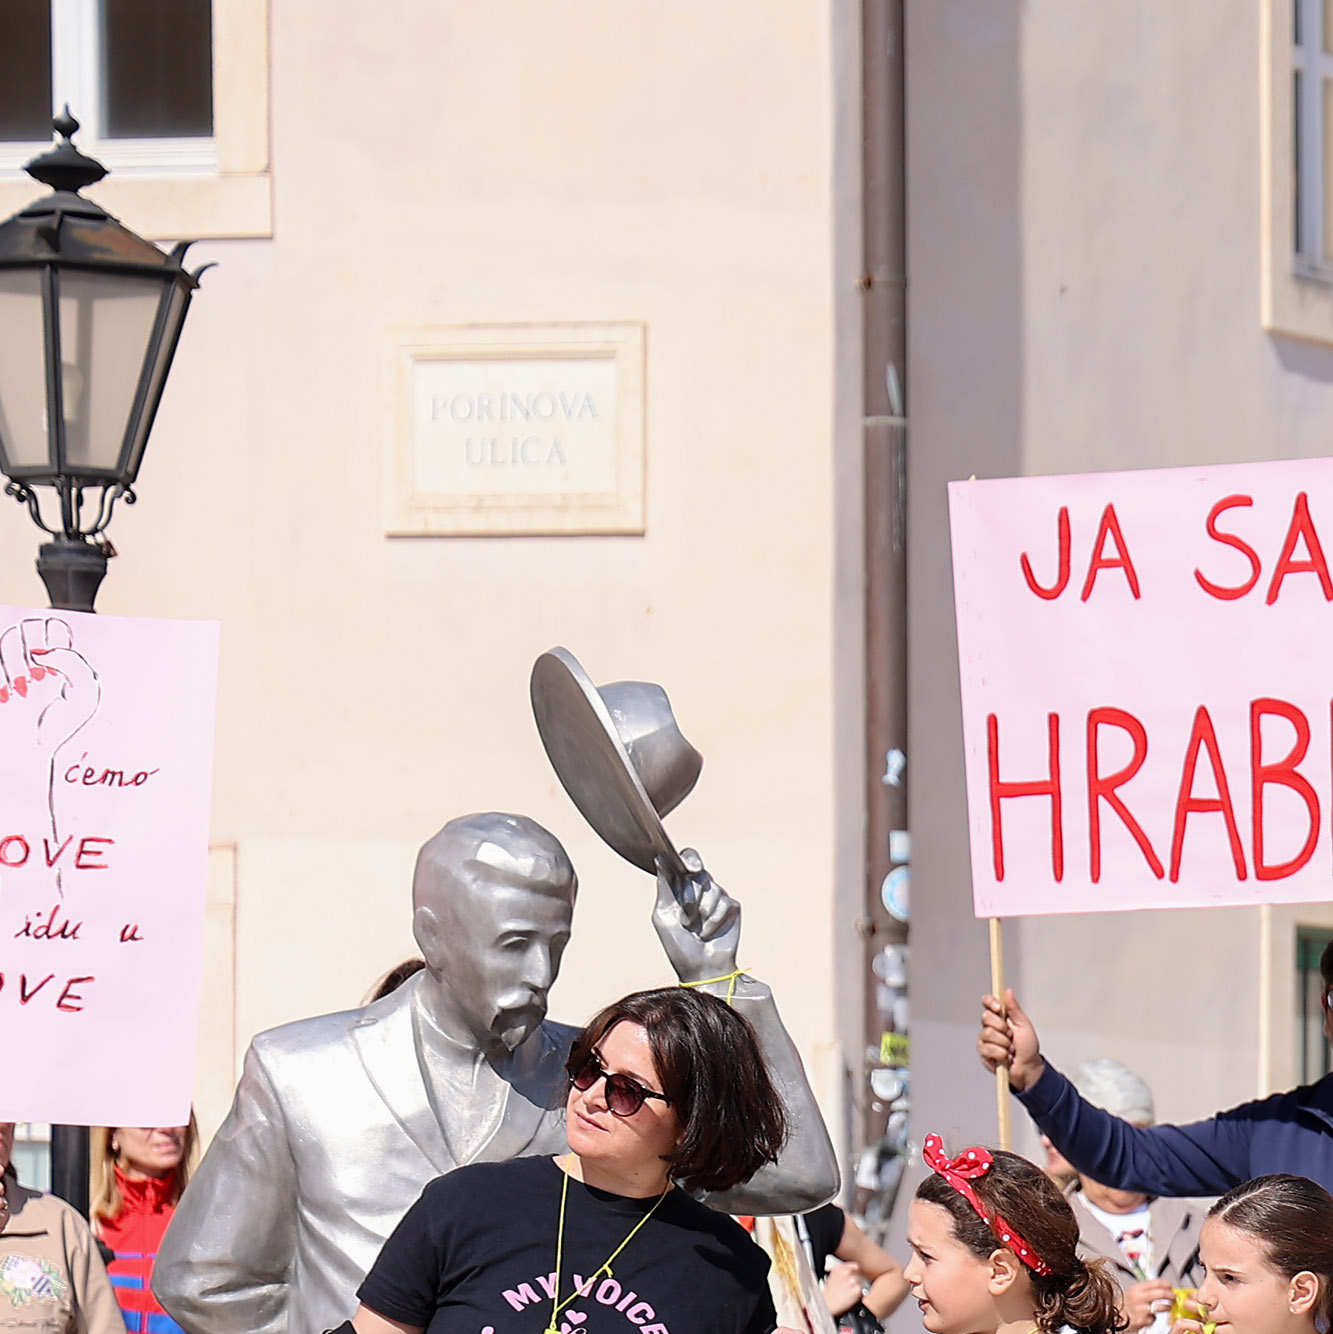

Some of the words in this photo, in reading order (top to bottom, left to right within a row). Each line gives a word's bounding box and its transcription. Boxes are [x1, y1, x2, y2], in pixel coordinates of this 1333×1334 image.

[464, 435, 567, 468] ULICA
[1019, 502, 1142, 604] JA
[14, 904, 82, 941] idu
[119, 923, 144, 943] u
[0, 971, 95, 1013] VE
[501, 1272, 557, 1312] MY
